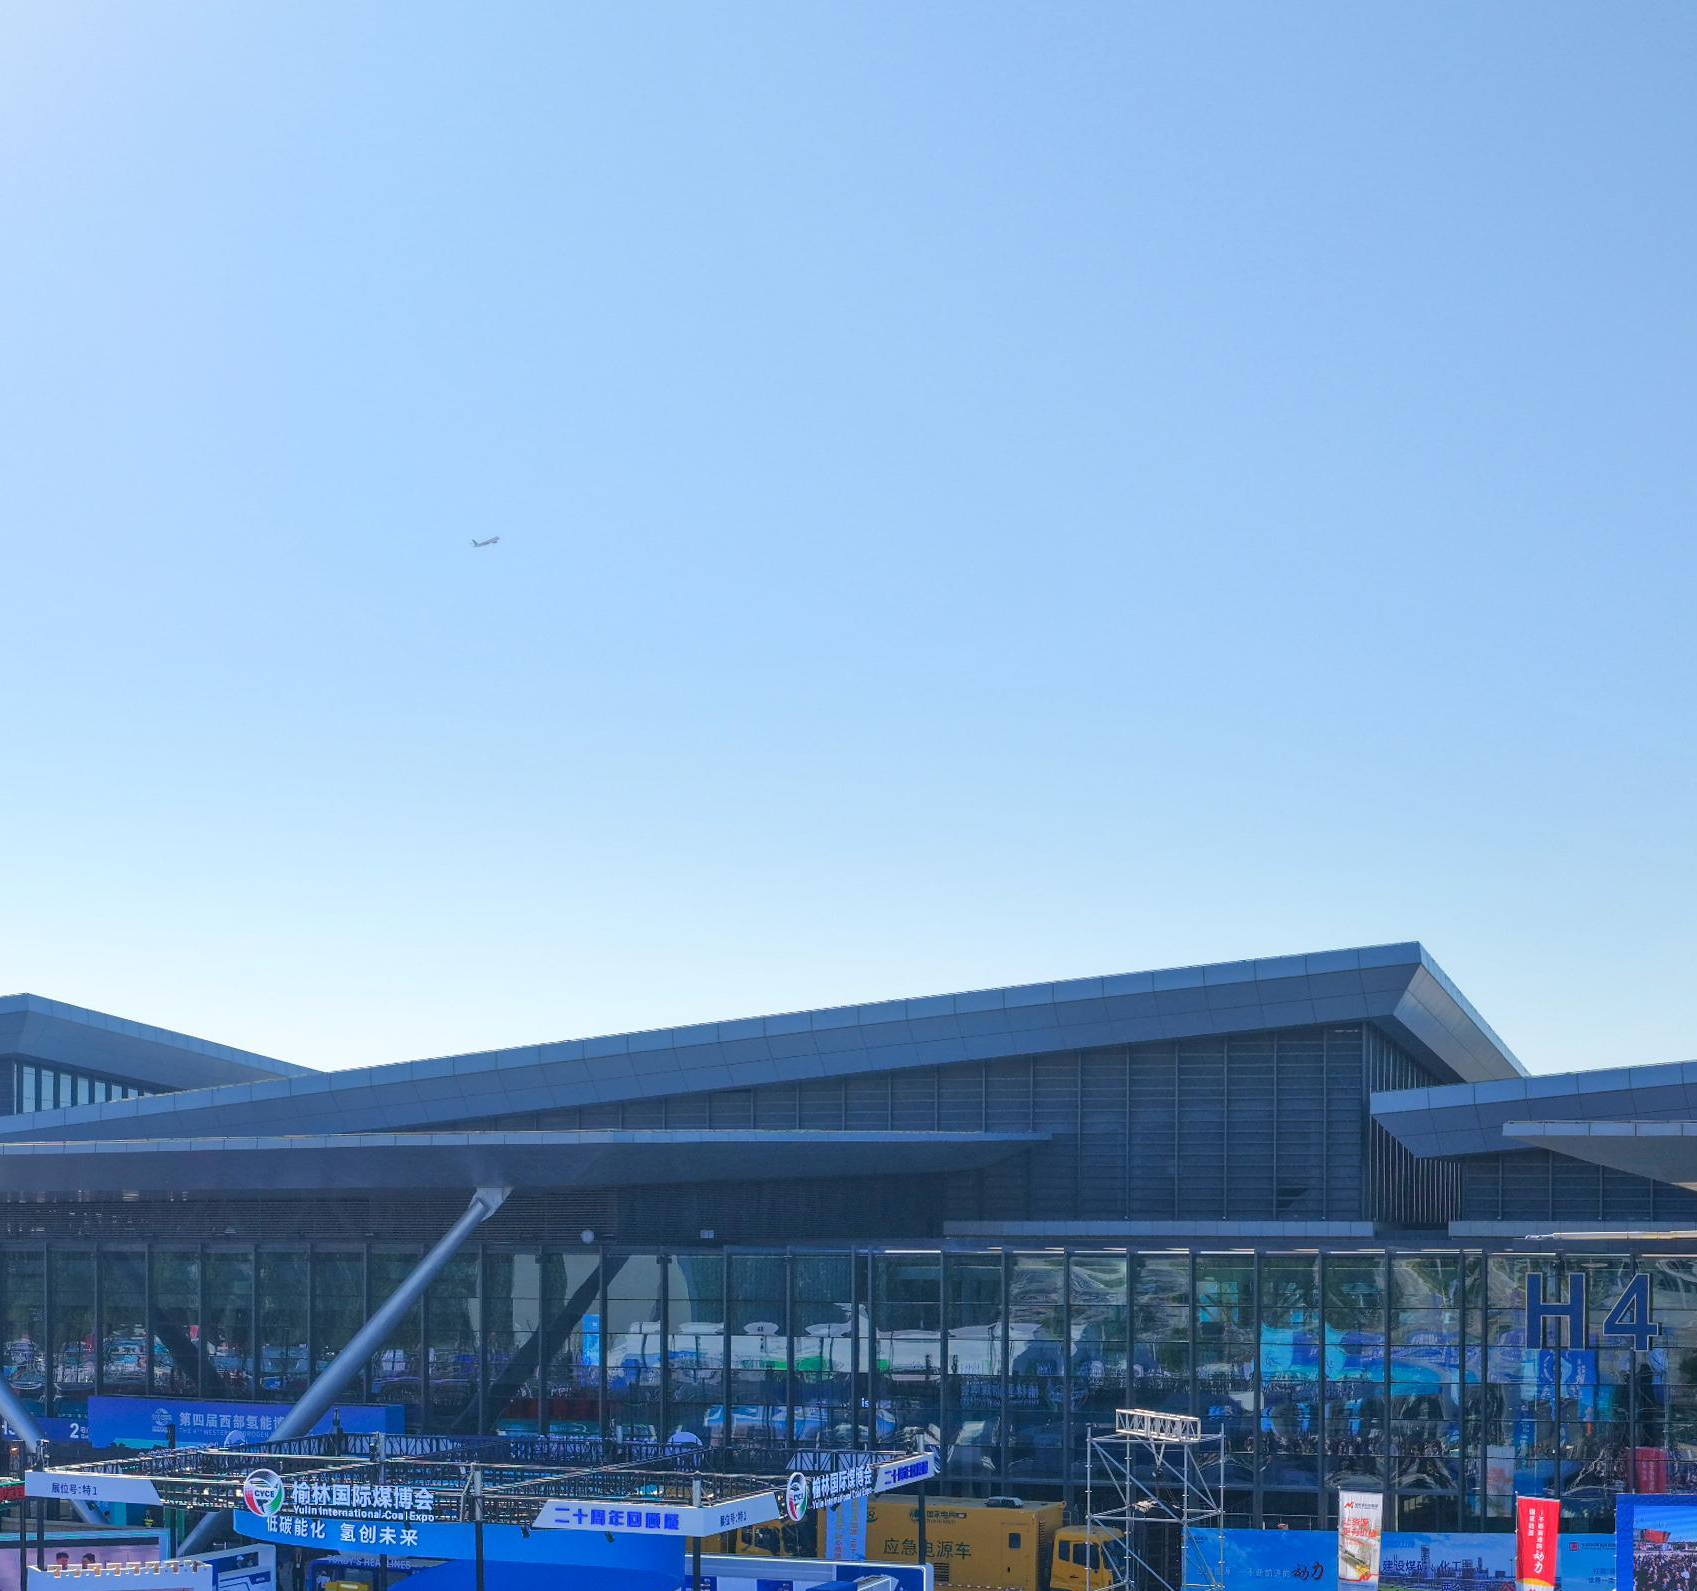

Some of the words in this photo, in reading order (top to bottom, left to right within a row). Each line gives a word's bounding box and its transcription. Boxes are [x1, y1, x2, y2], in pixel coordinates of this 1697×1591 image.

[1524, 1271, 1661, 1352] H4
[70, 1423, 78, 1438] 2
[811, 1464, 873, 1500] 榆林国际煤博会
[292, 1482, 435, 1512] 榆林国际煤博会
[293, 1505, 317, 1515] Yulin
[318, 1507, 383, 1520] International
[409, 1511, 435, 1523] Expo
[554, 1507, 680, 1531] 二十周年回顾展
[266, 1515, 326, 1541] 低碳能化
[339, 1522, 419, 1547] 氢创未来
[884, 1537, 972, 1560] 应急电源车
